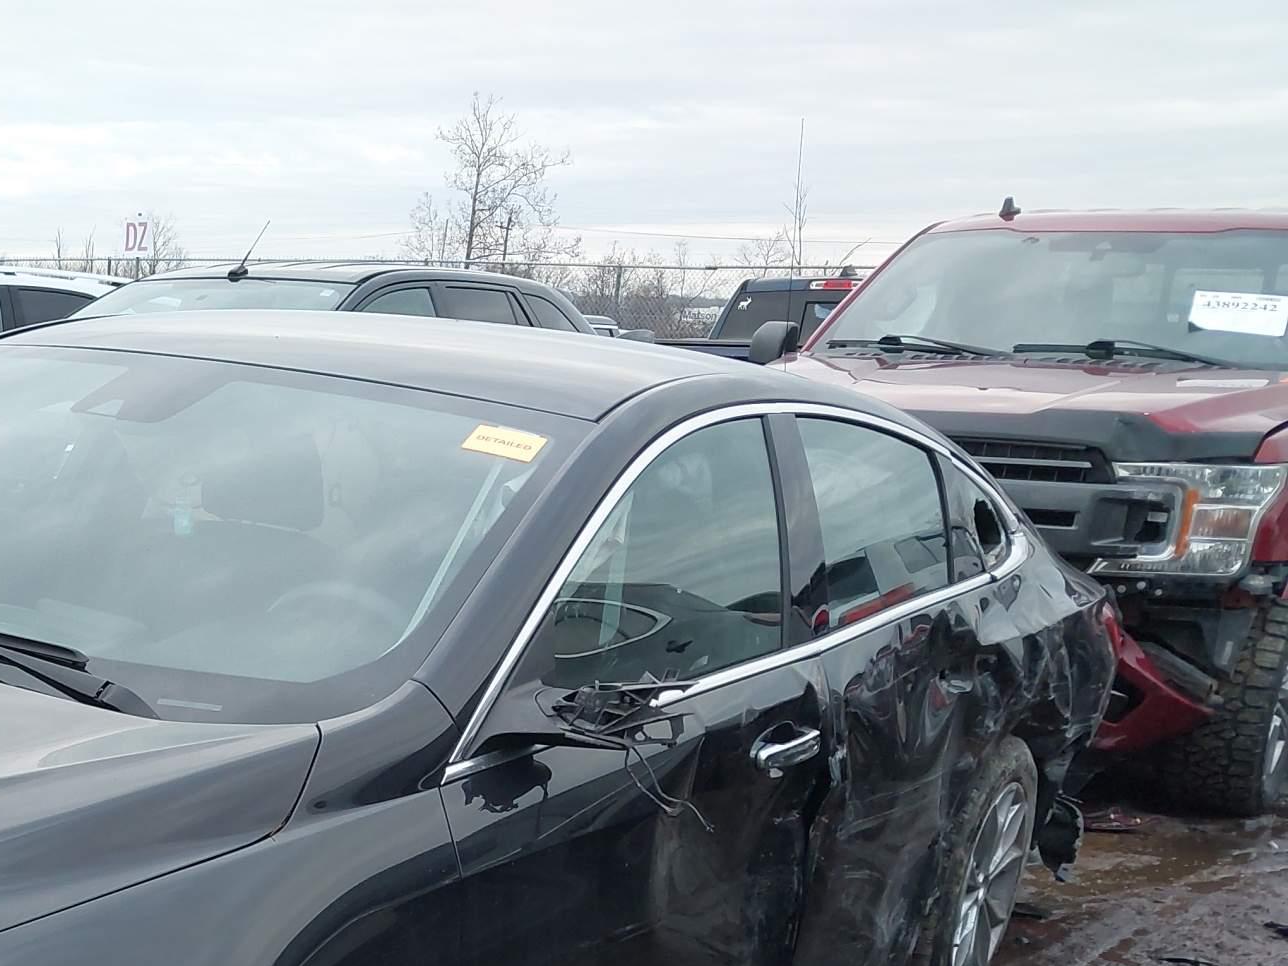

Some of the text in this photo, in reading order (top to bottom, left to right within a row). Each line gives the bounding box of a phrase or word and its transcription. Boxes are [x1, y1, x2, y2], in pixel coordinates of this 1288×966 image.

[124, 221, 148, 252] DZ
[1201, 300, 1279, 312] 43892242
[475, 434, 533, 451] DETAILED
